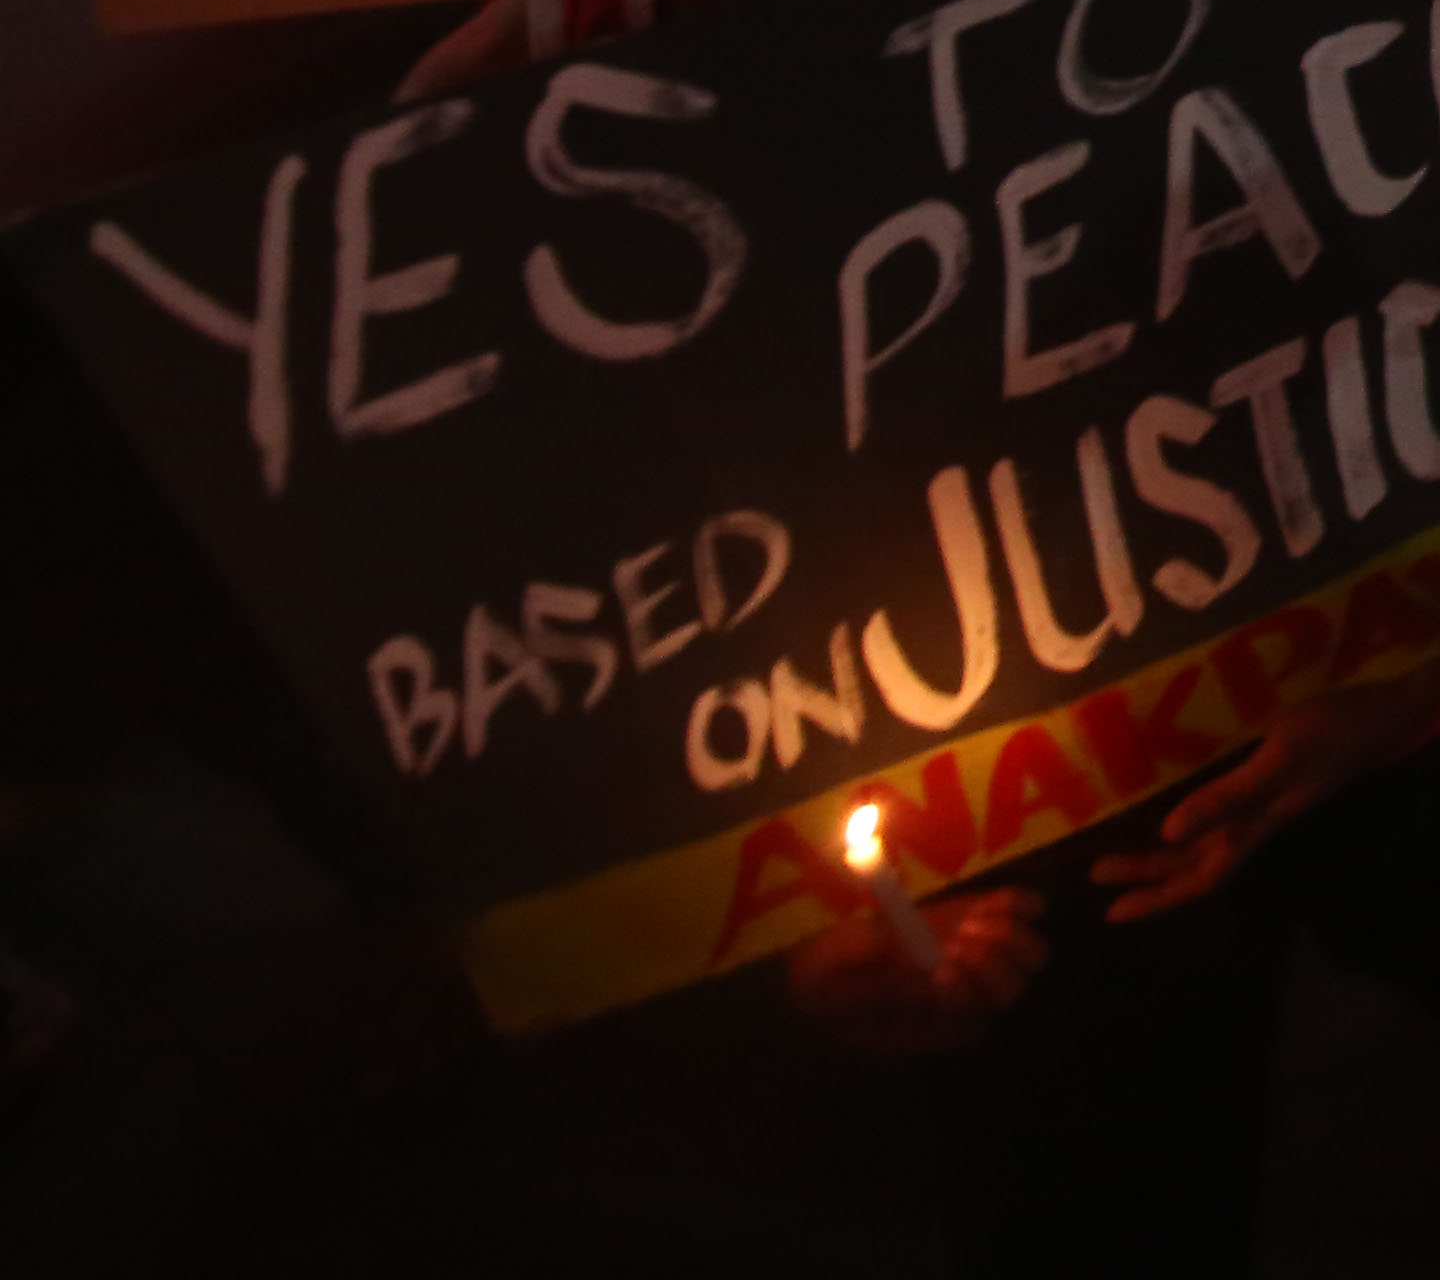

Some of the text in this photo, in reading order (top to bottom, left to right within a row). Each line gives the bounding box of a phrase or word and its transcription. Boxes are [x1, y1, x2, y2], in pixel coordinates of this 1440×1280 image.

[89, 62, 750, 498] YES
[366, 505, 796, 778] BASED
[683, 623, 864, 795] ON
